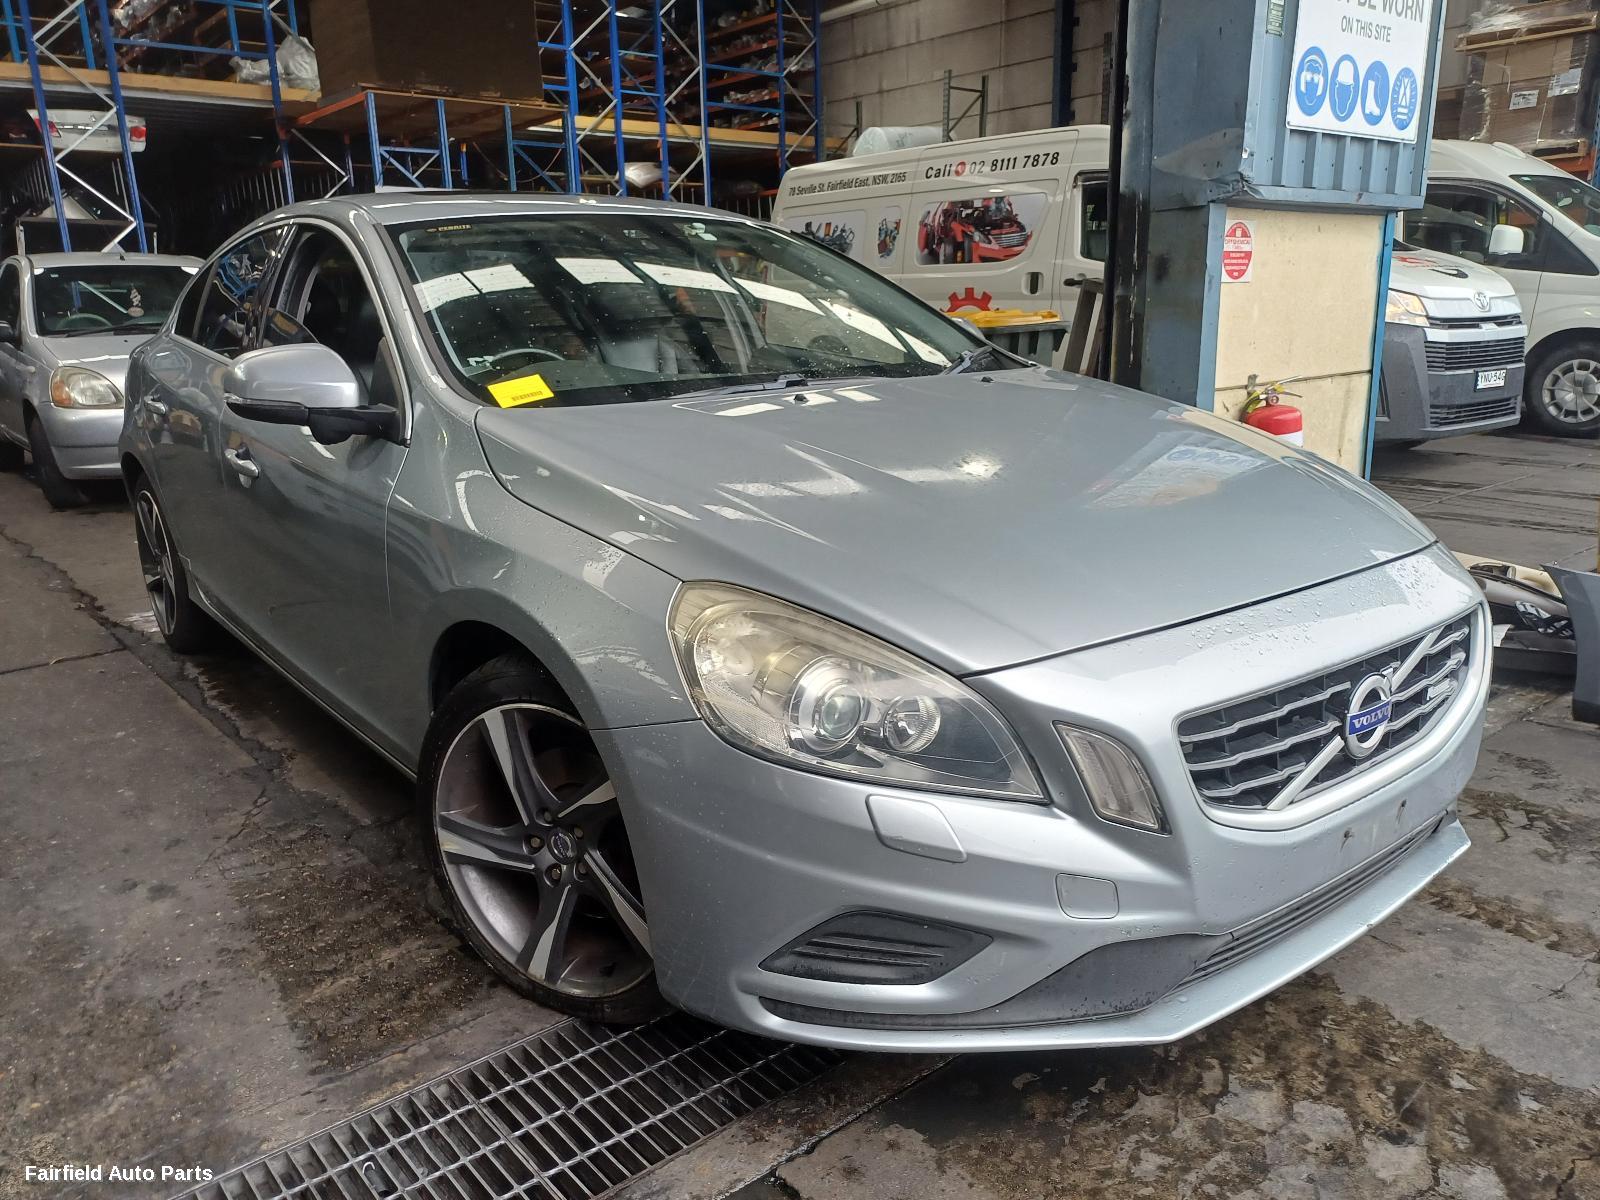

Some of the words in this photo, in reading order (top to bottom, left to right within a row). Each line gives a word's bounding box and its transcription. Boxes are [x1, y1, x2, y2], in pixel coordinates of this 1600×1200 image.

[1382, 0, 1424, 23] WORN
[1340, 15, 1354, 34] ON
[1355, 18, 1373, 39] THIS
[1374, 23, 1392, 43] SITE
[969, 160, 985, 174] 02
[990, 156, 1017, 172] 8111
[1022, 151, 1060, 168] 7878
[826, 177, 854, 191] Fairfield
[1352, 705, 1391, 729] VOLVO
